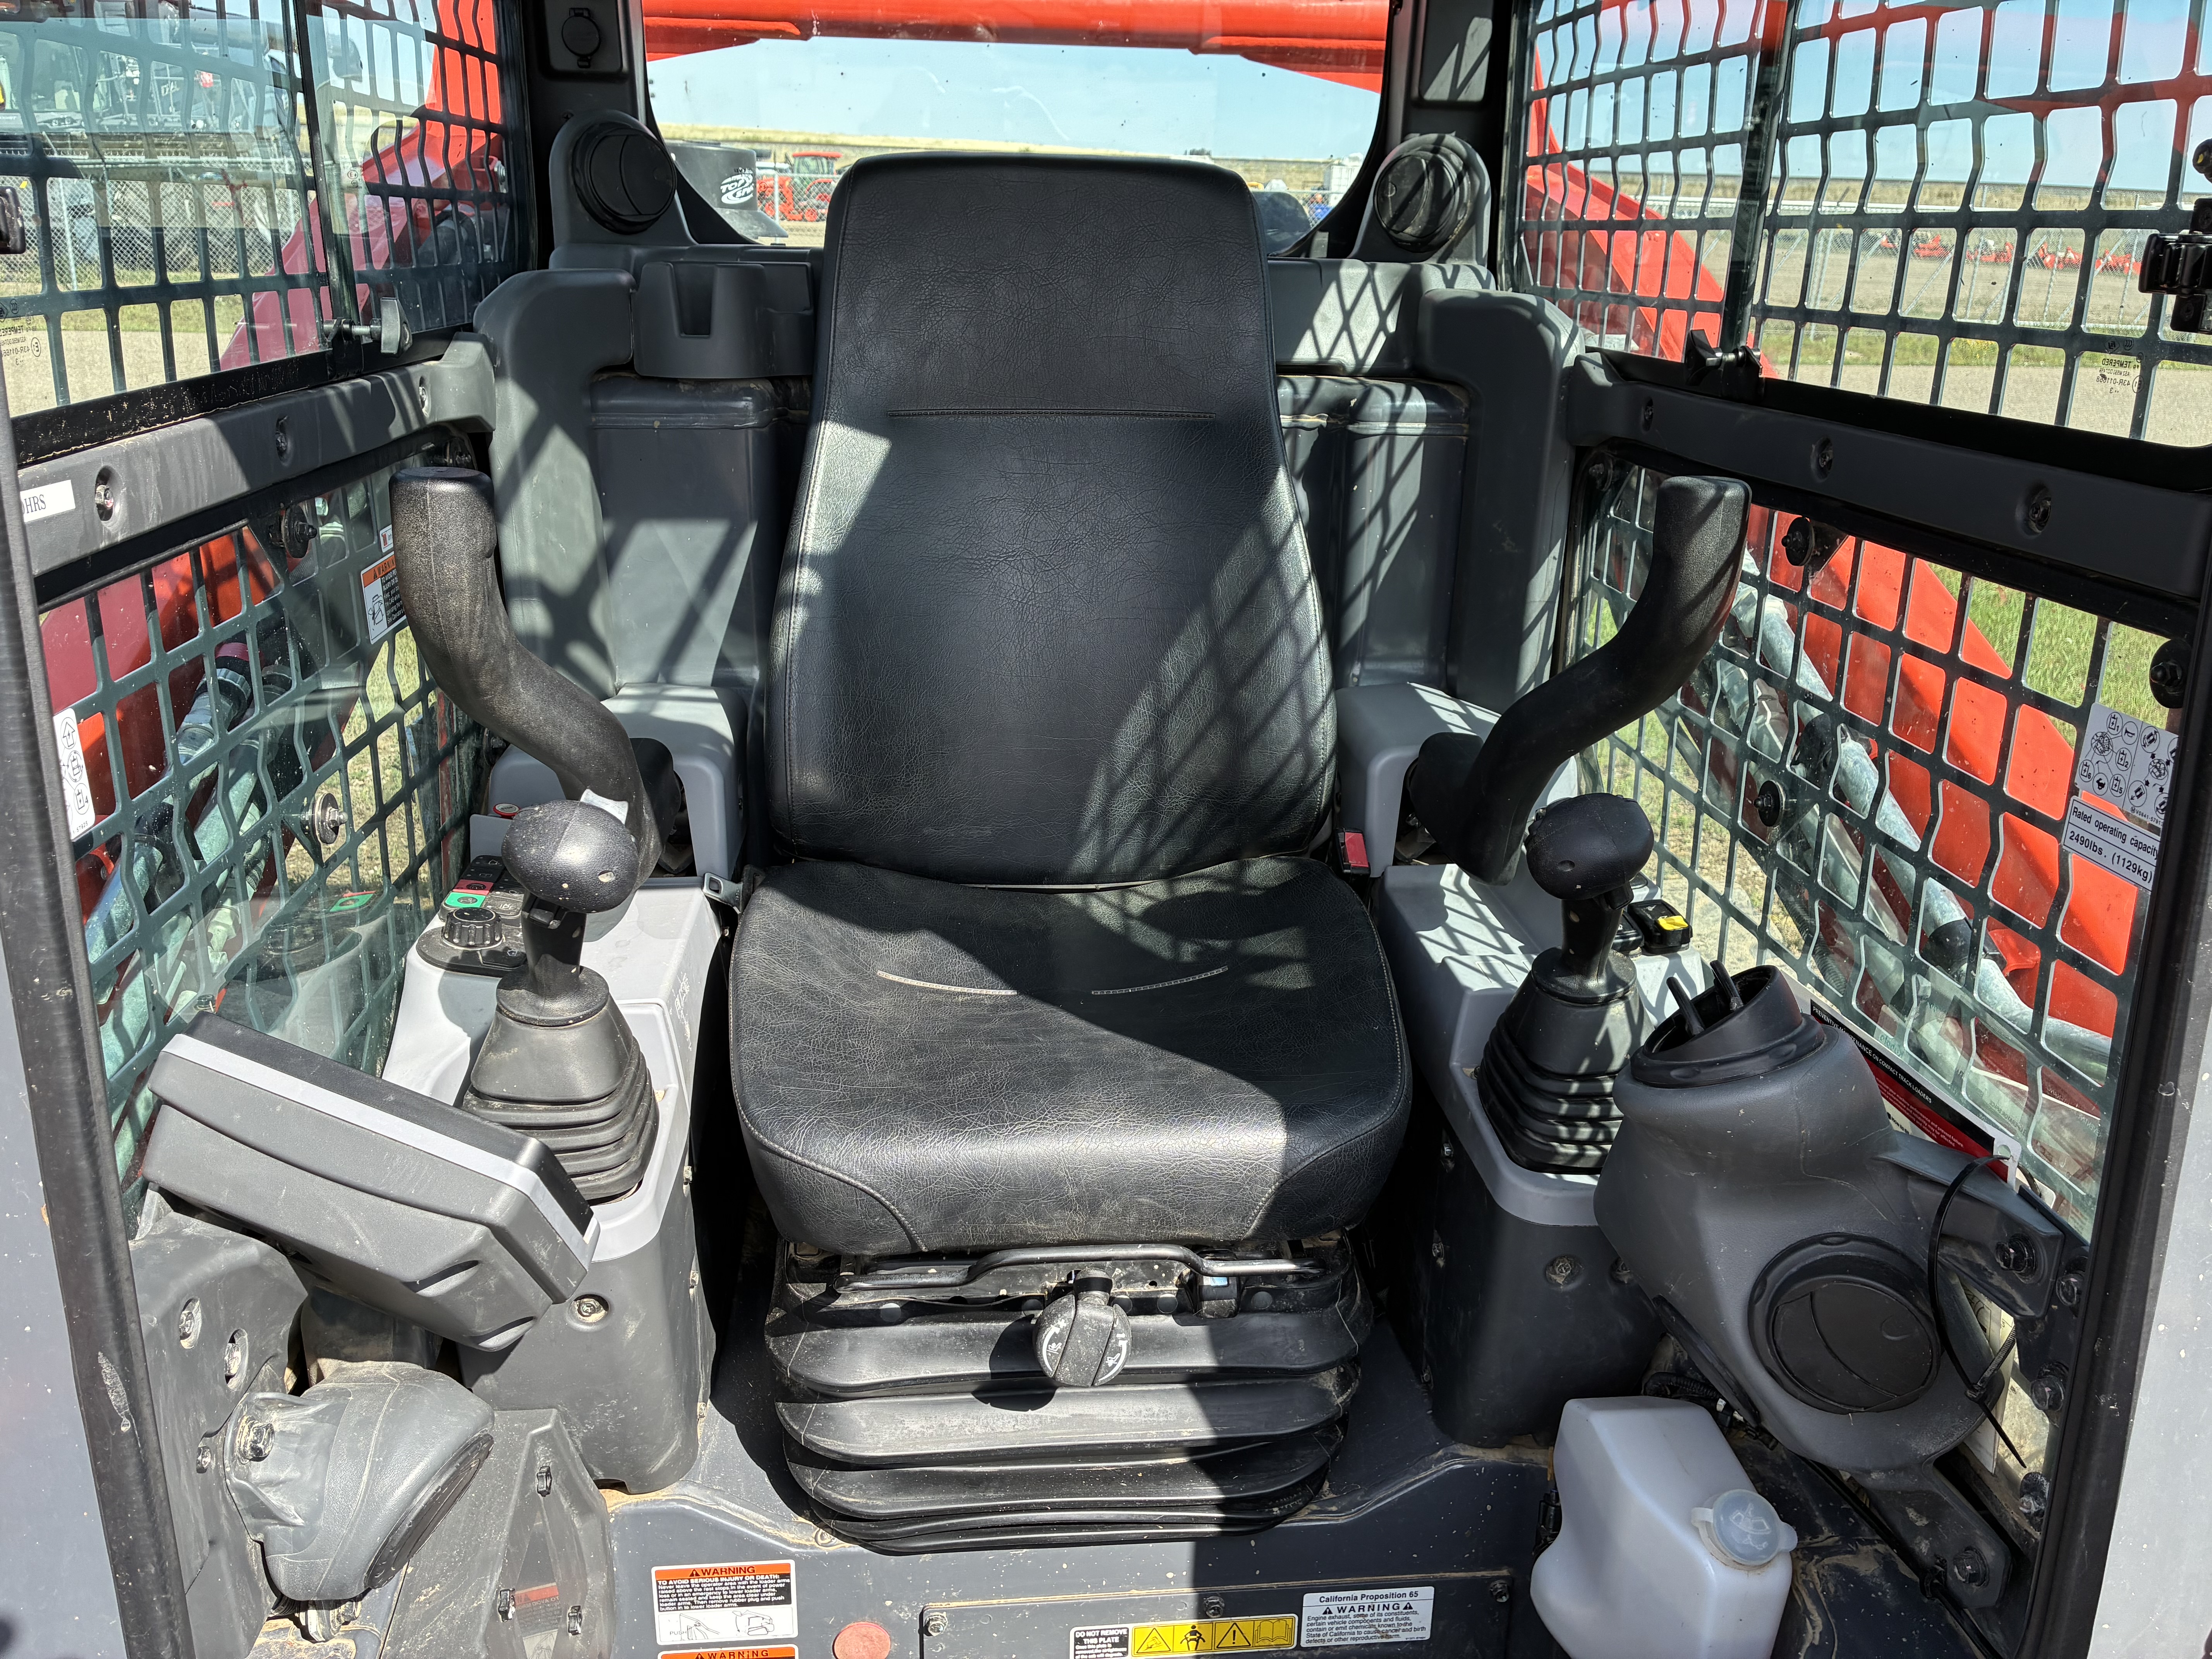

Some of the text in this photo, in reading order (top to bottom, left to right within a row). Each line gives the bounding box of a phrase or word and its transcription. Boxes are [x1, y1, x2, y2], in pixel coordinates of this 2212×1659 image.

[2072, 806, 2159, 860] Rated operating capacity
[2112, 852, 2153, 883] (1129kg)
[1813, 1006, 1839, 1029] PREVENTIVE
[1873, 1053, 1879, 1062] ON
[1879, 1059, 1898, 1076] COMPACT
[1899, 1073, 1911, 1088] TRACK
[1912, 1085, 1932, 1103] LOADERS
[701, 1566, 756, 1576] WARNING
[1319, 1594, 1358, 1603] California
[1360, 1592, 1407, 1601] Proposition
[1337, 1603, 1400, 1613] WARNING
[708, 1650, 769, 1659] WARNING
